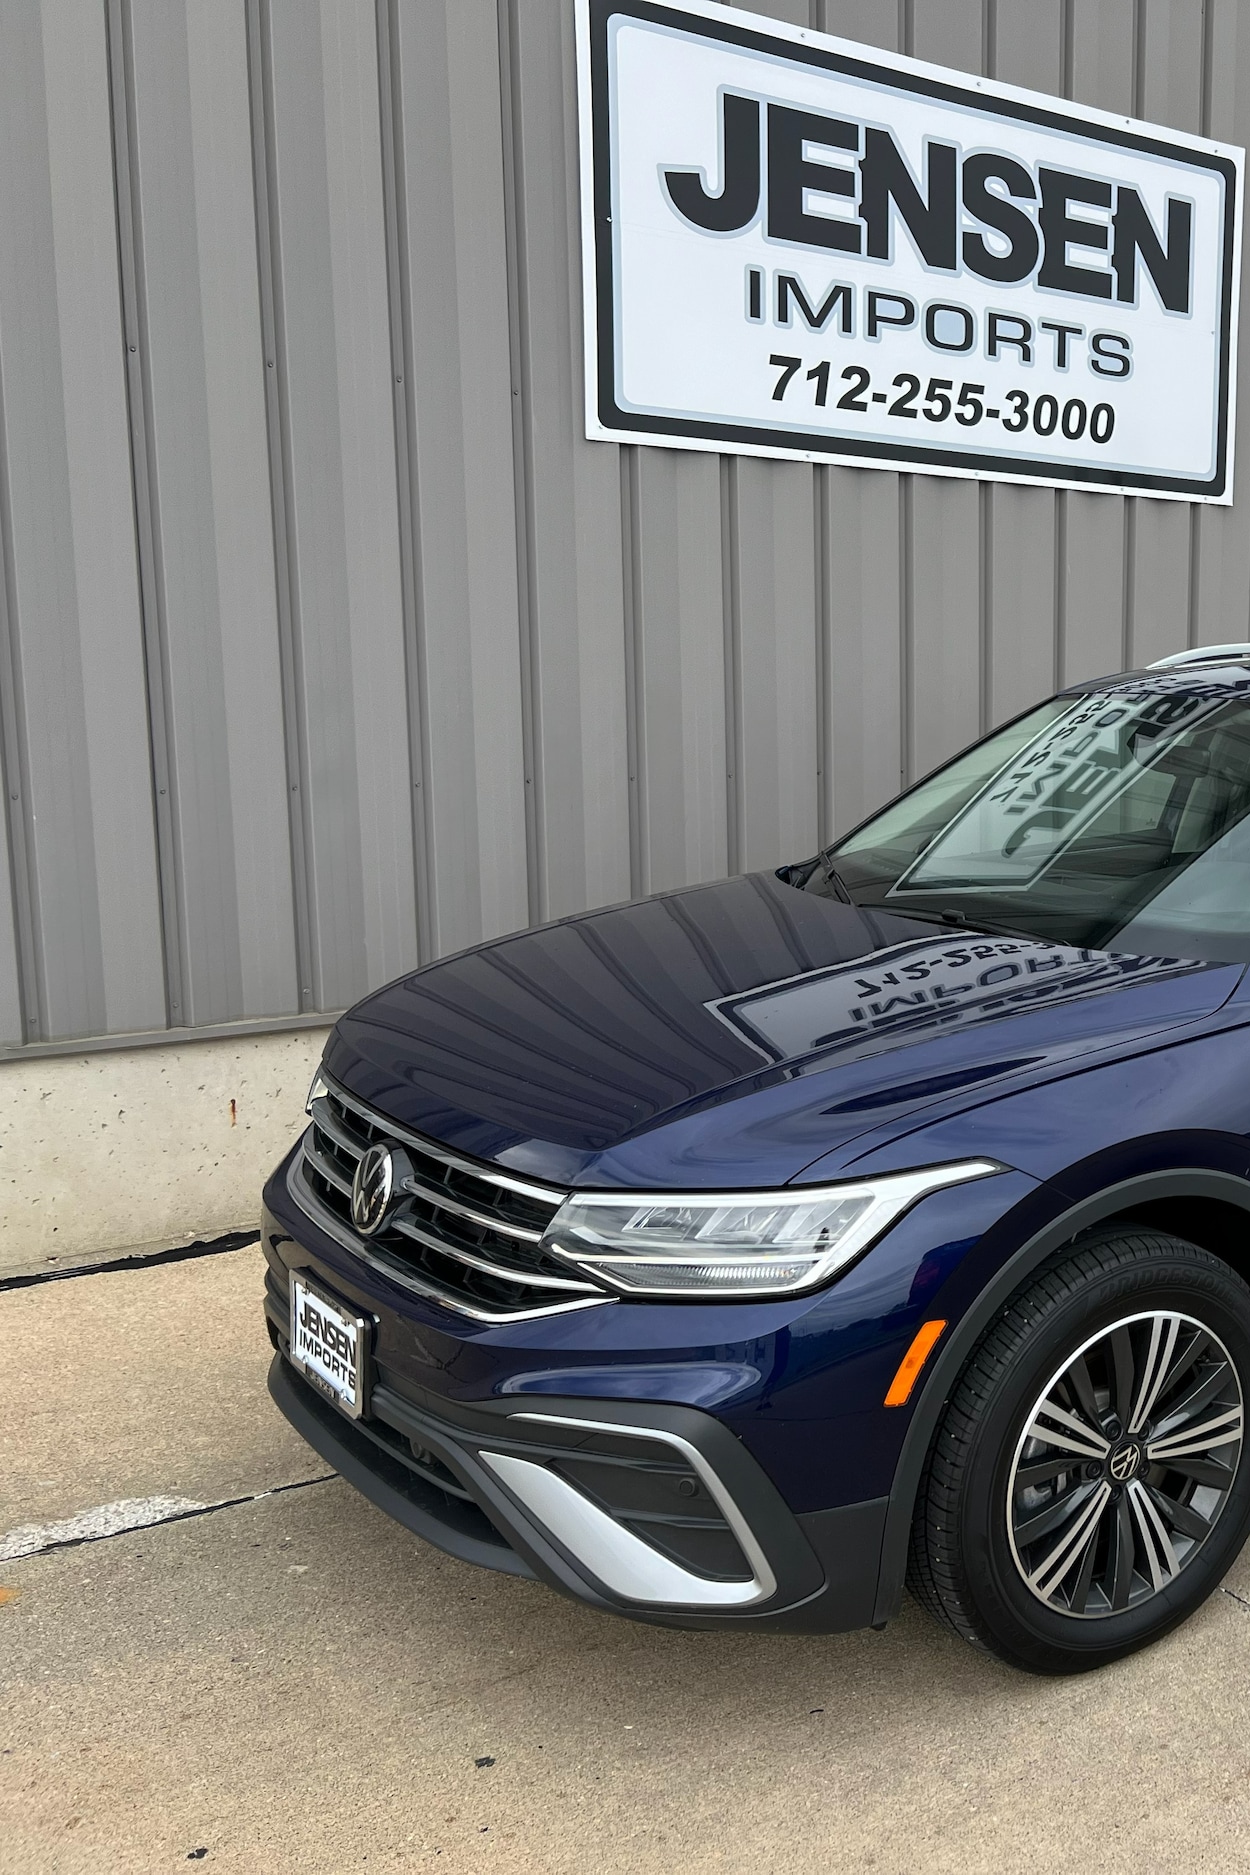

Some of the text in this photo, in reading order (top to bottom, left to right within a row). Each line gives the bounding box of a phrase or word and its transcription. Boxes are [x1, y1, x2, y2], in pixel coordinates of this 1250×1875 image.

[659, 86, 1195, 317] JENSEN
[747, 268, 1133, 380] IMPORTS
[767, 354, 1117, 445] 712-255-3000
[299, 1328, 356, 1390] IMPORTS
[300, 1301, 356, 1368] JENSEN
